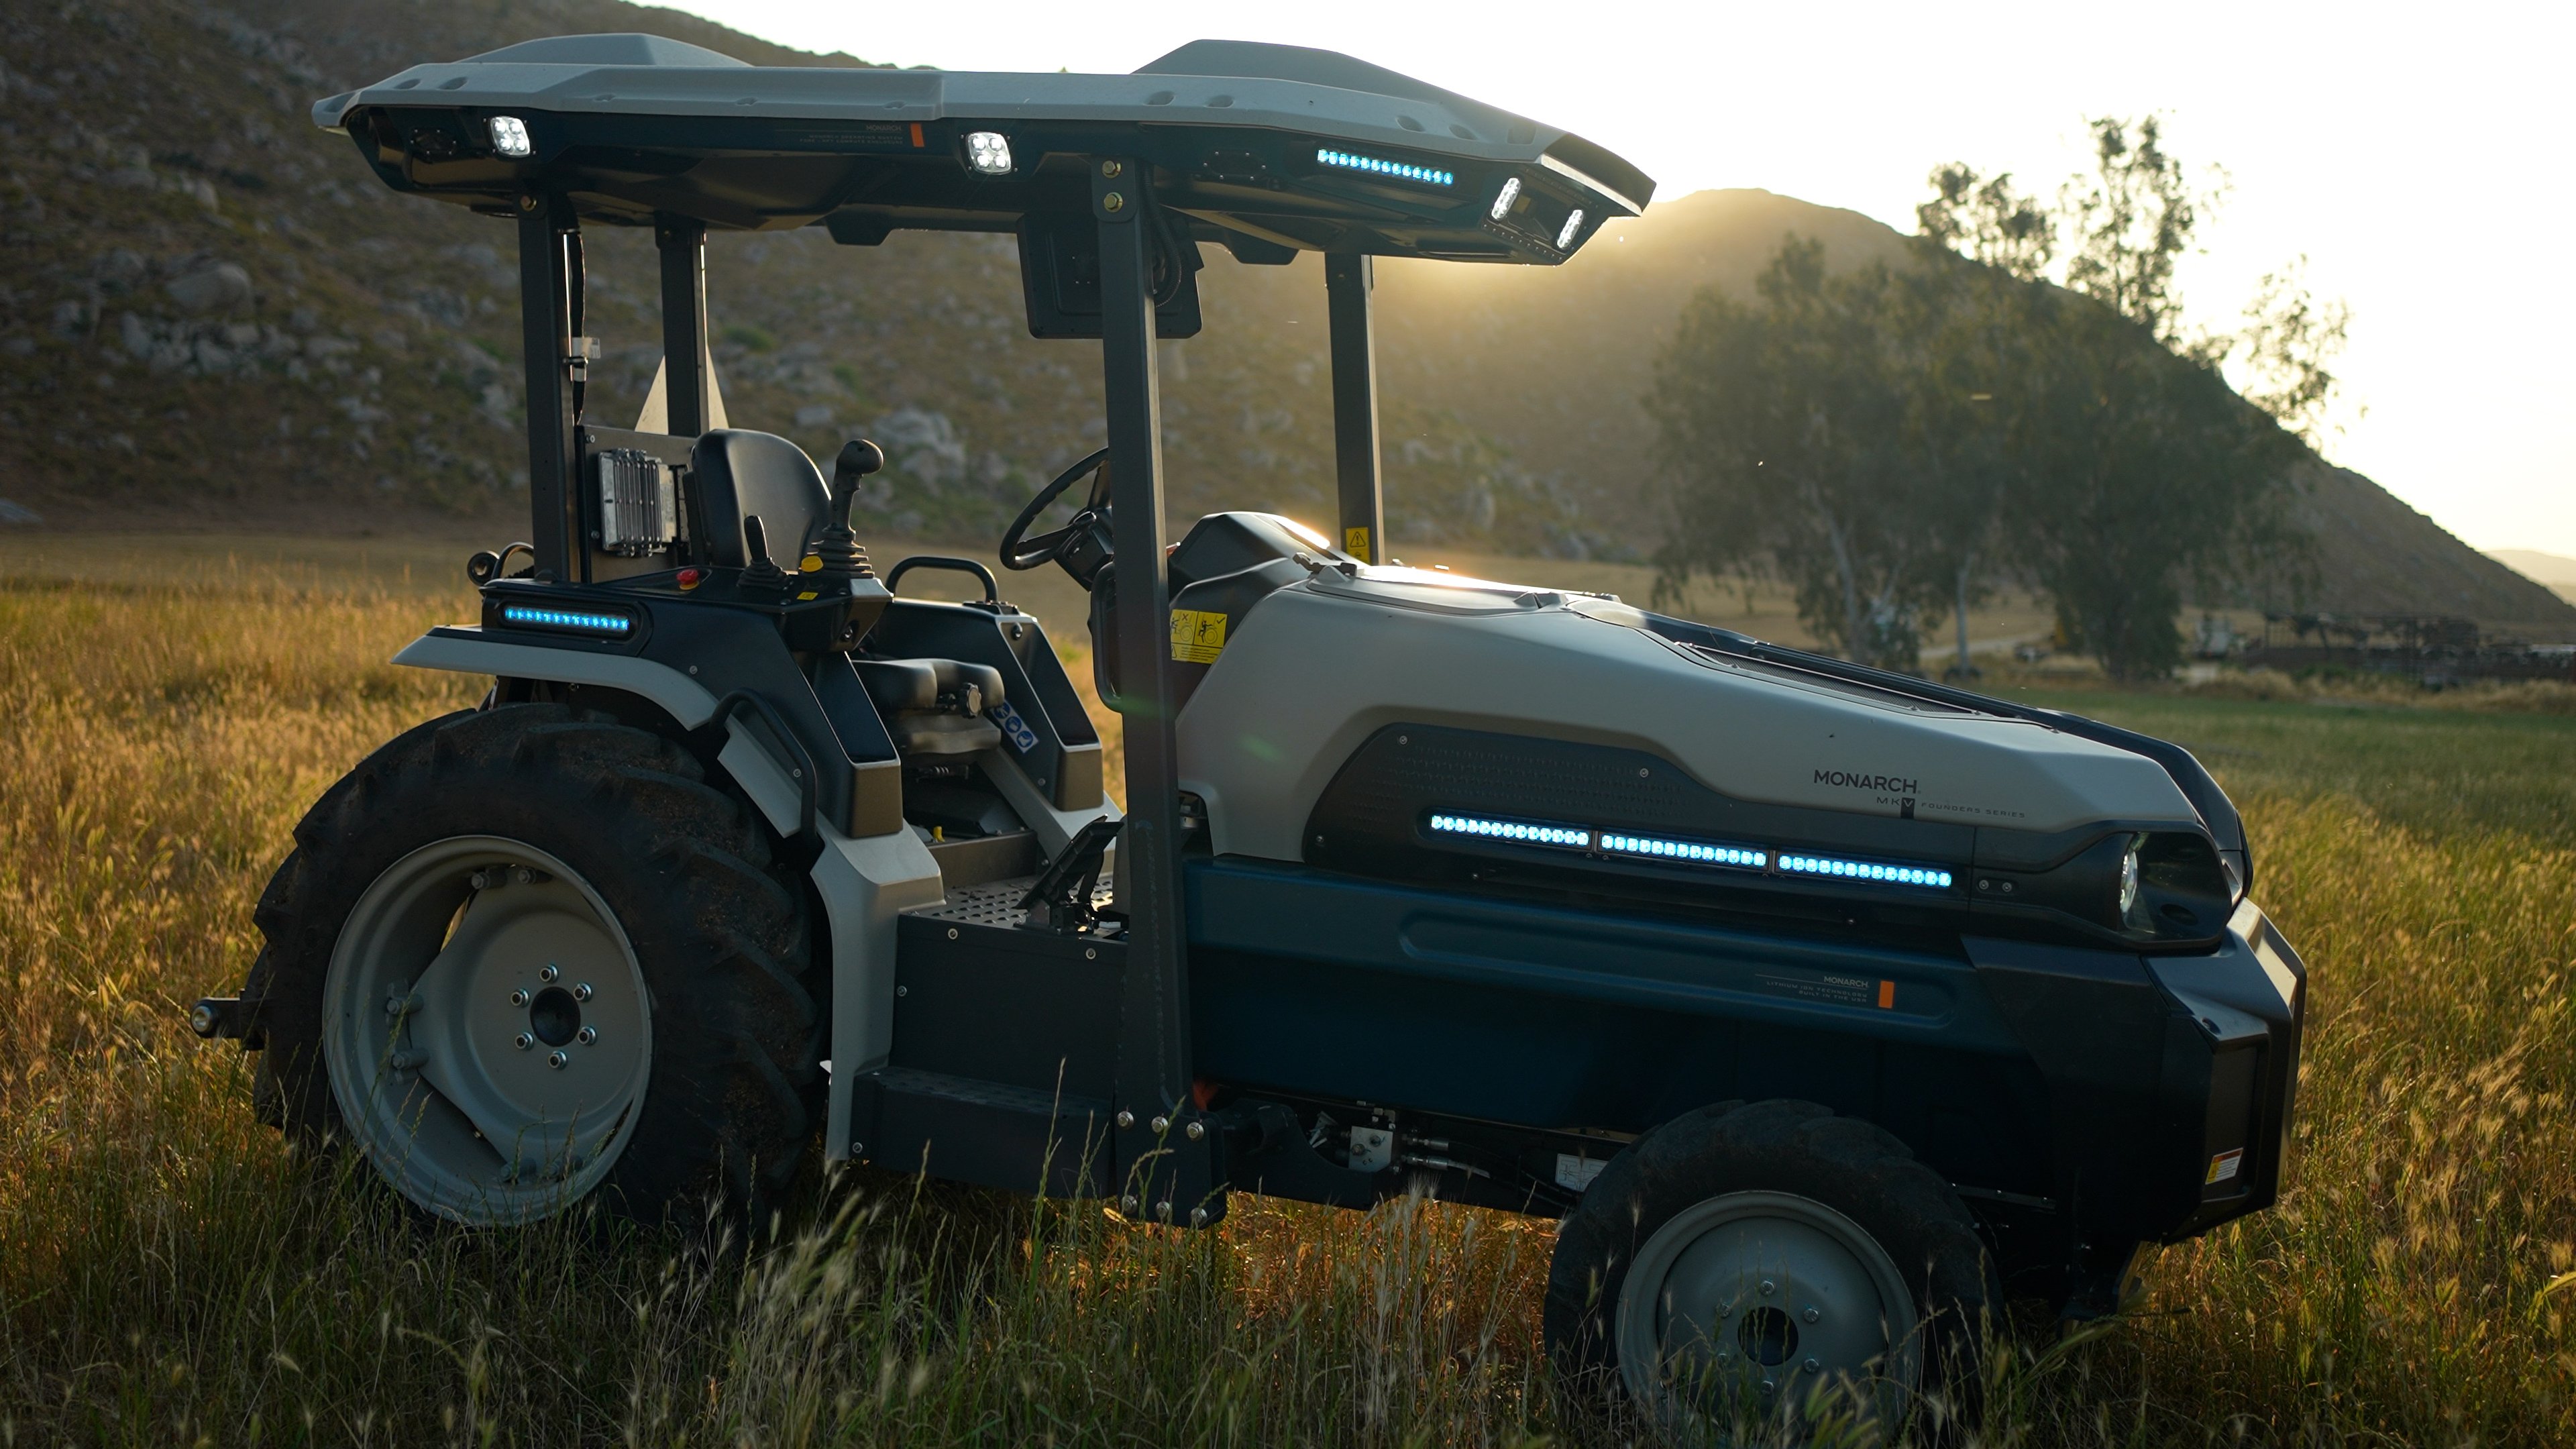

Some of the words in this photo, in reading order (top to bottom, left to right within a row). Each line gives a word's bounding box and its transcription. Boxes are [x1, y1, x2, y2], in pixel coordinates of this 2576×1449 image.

[1813, 769, 1917, 794] MONARCH
[1921, 802, 1981, 814] FOUNDERS
[1985, 809, 2025, 818] SERIES
[1823, 976, 1868, 987] MONARCH
[1817, 987, 1868, 997] TECHNOLOGY
